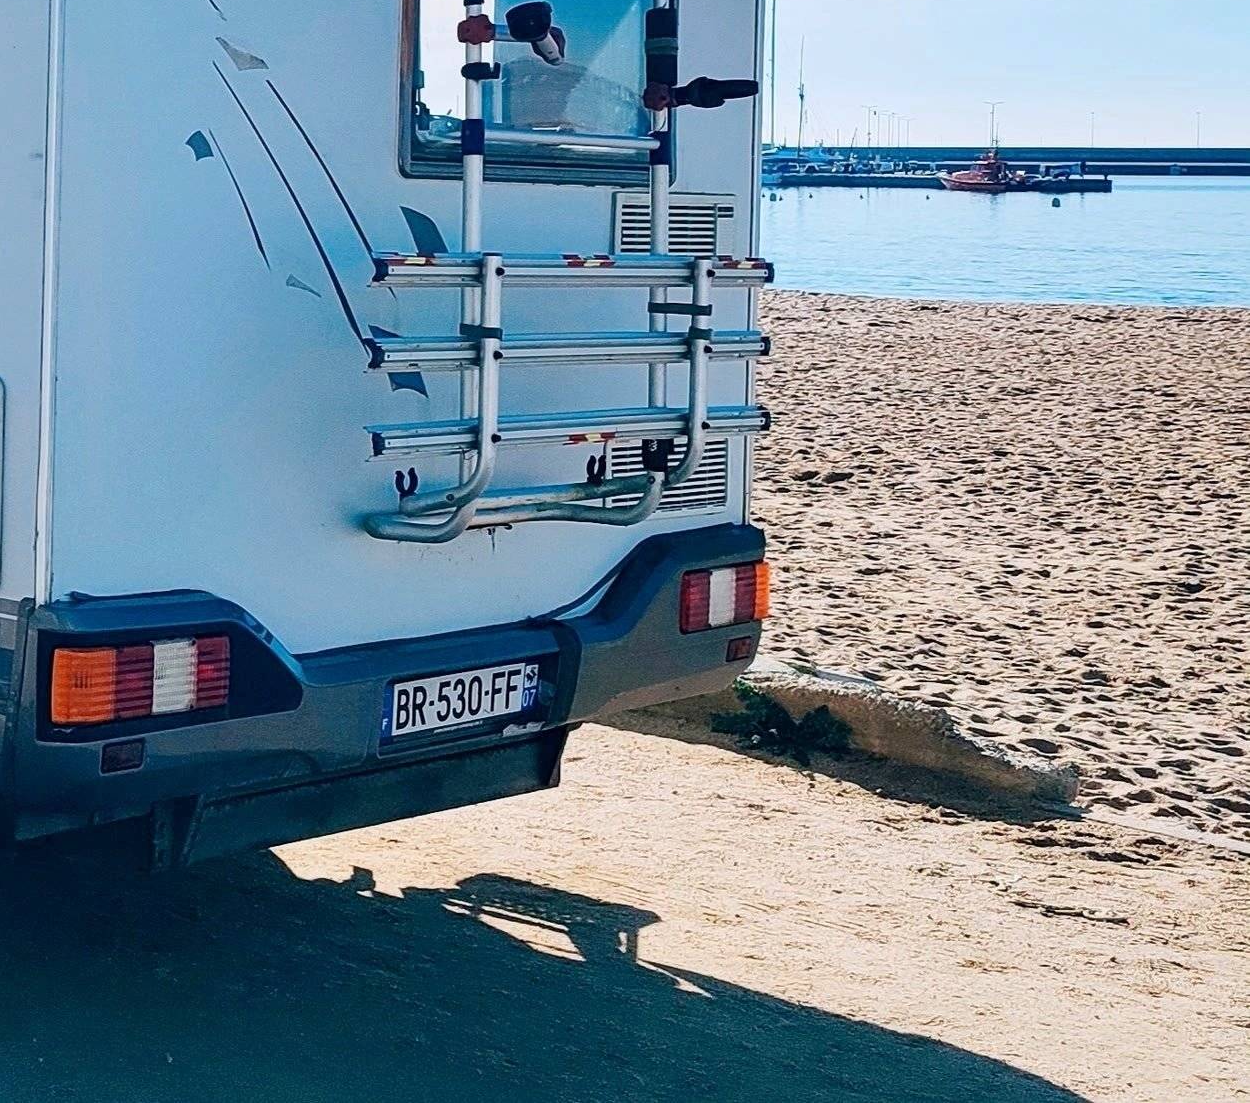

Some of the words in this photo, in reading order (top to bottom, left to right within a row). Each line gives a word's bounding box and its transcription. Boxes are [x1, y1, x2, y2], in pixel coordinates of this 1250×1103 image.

[396, 669, 522, 730] BR-530-FF
[523, 690, 536, 706] 07
[382, 718, 389, 730] F
